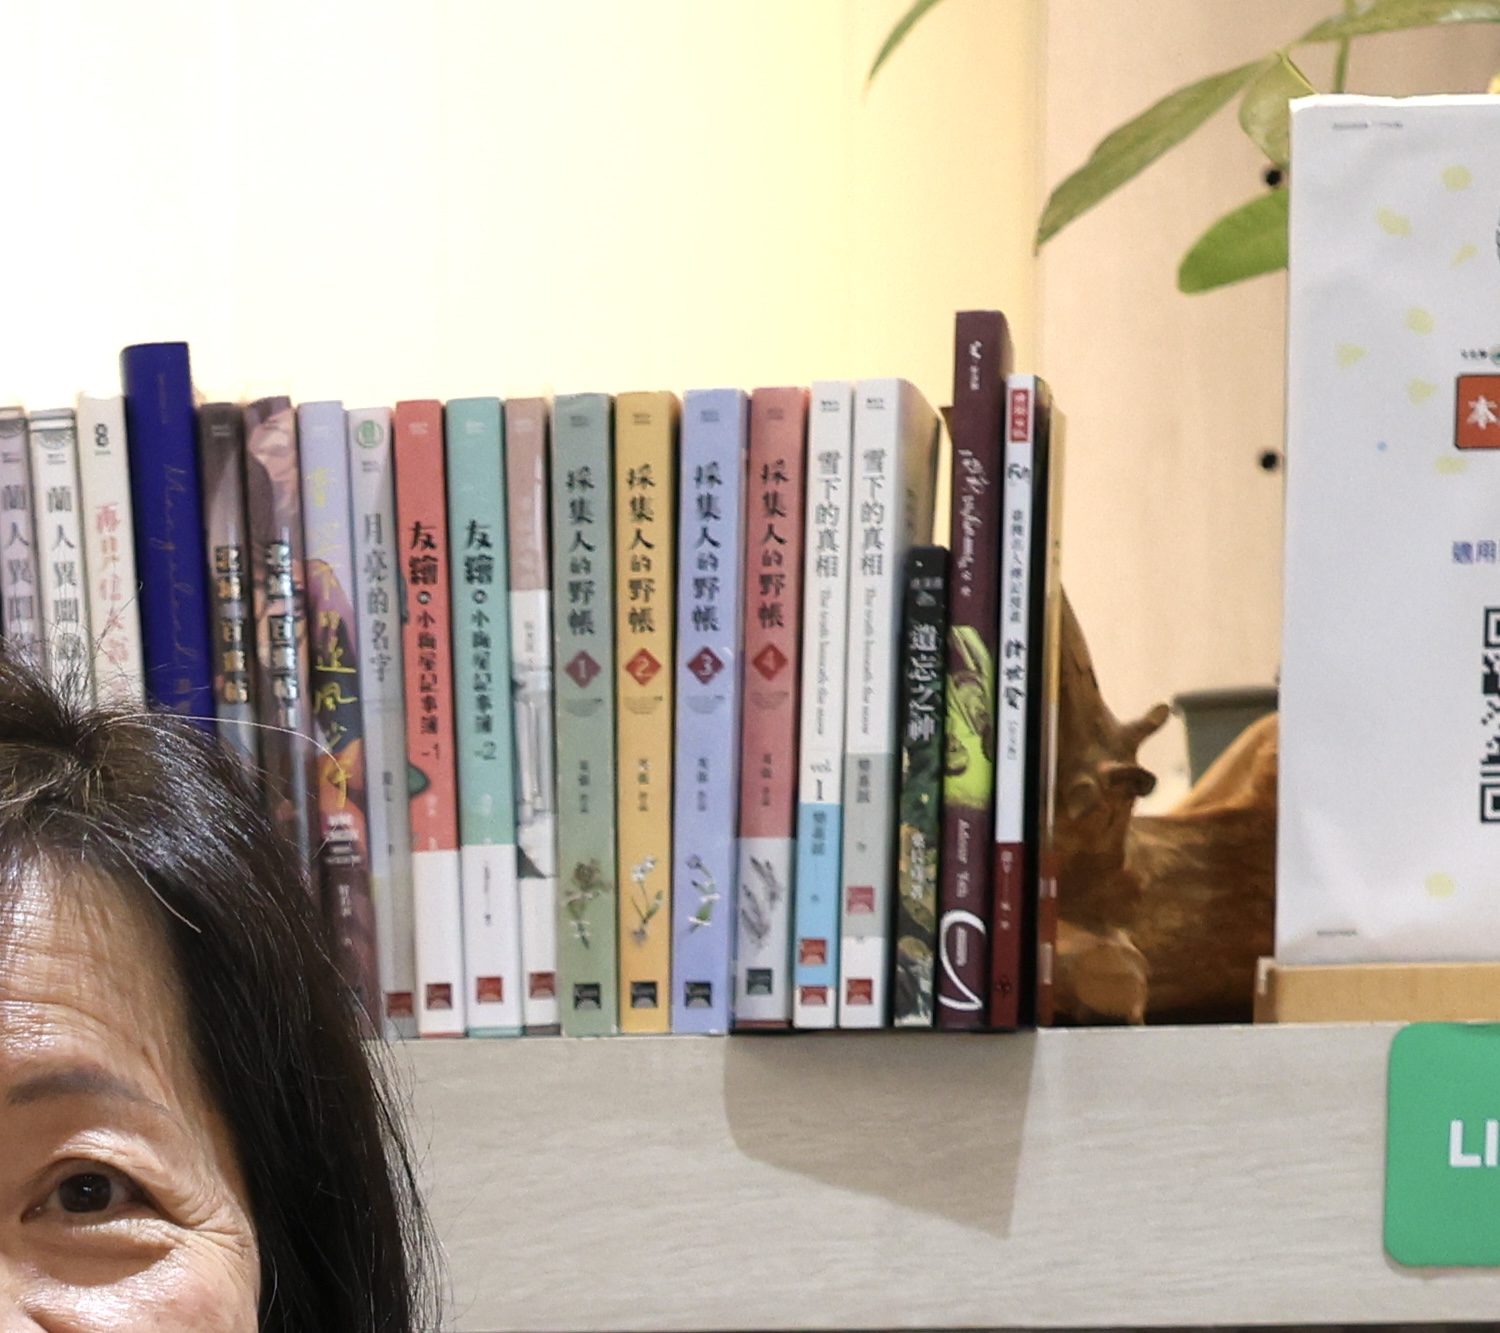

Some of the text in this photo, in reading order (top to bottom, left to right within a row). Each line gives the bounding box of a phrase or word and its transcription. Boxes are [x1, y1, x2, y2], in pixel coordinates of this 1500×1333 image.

[364, 512, 392, 683] 月亮的名字
[564, 466, 597, 682] 採集人的野帳 1
[627, 463, 656, 680] 採集人的野帳 2
[694, 461, 722, 679] 採集人的野帳 3
[760, 459, 790, 674] 採集人的野帳 4
[815, 451, 842, 580] 雪下的真相
[861, 449, 888, 578] 雪下的真相
